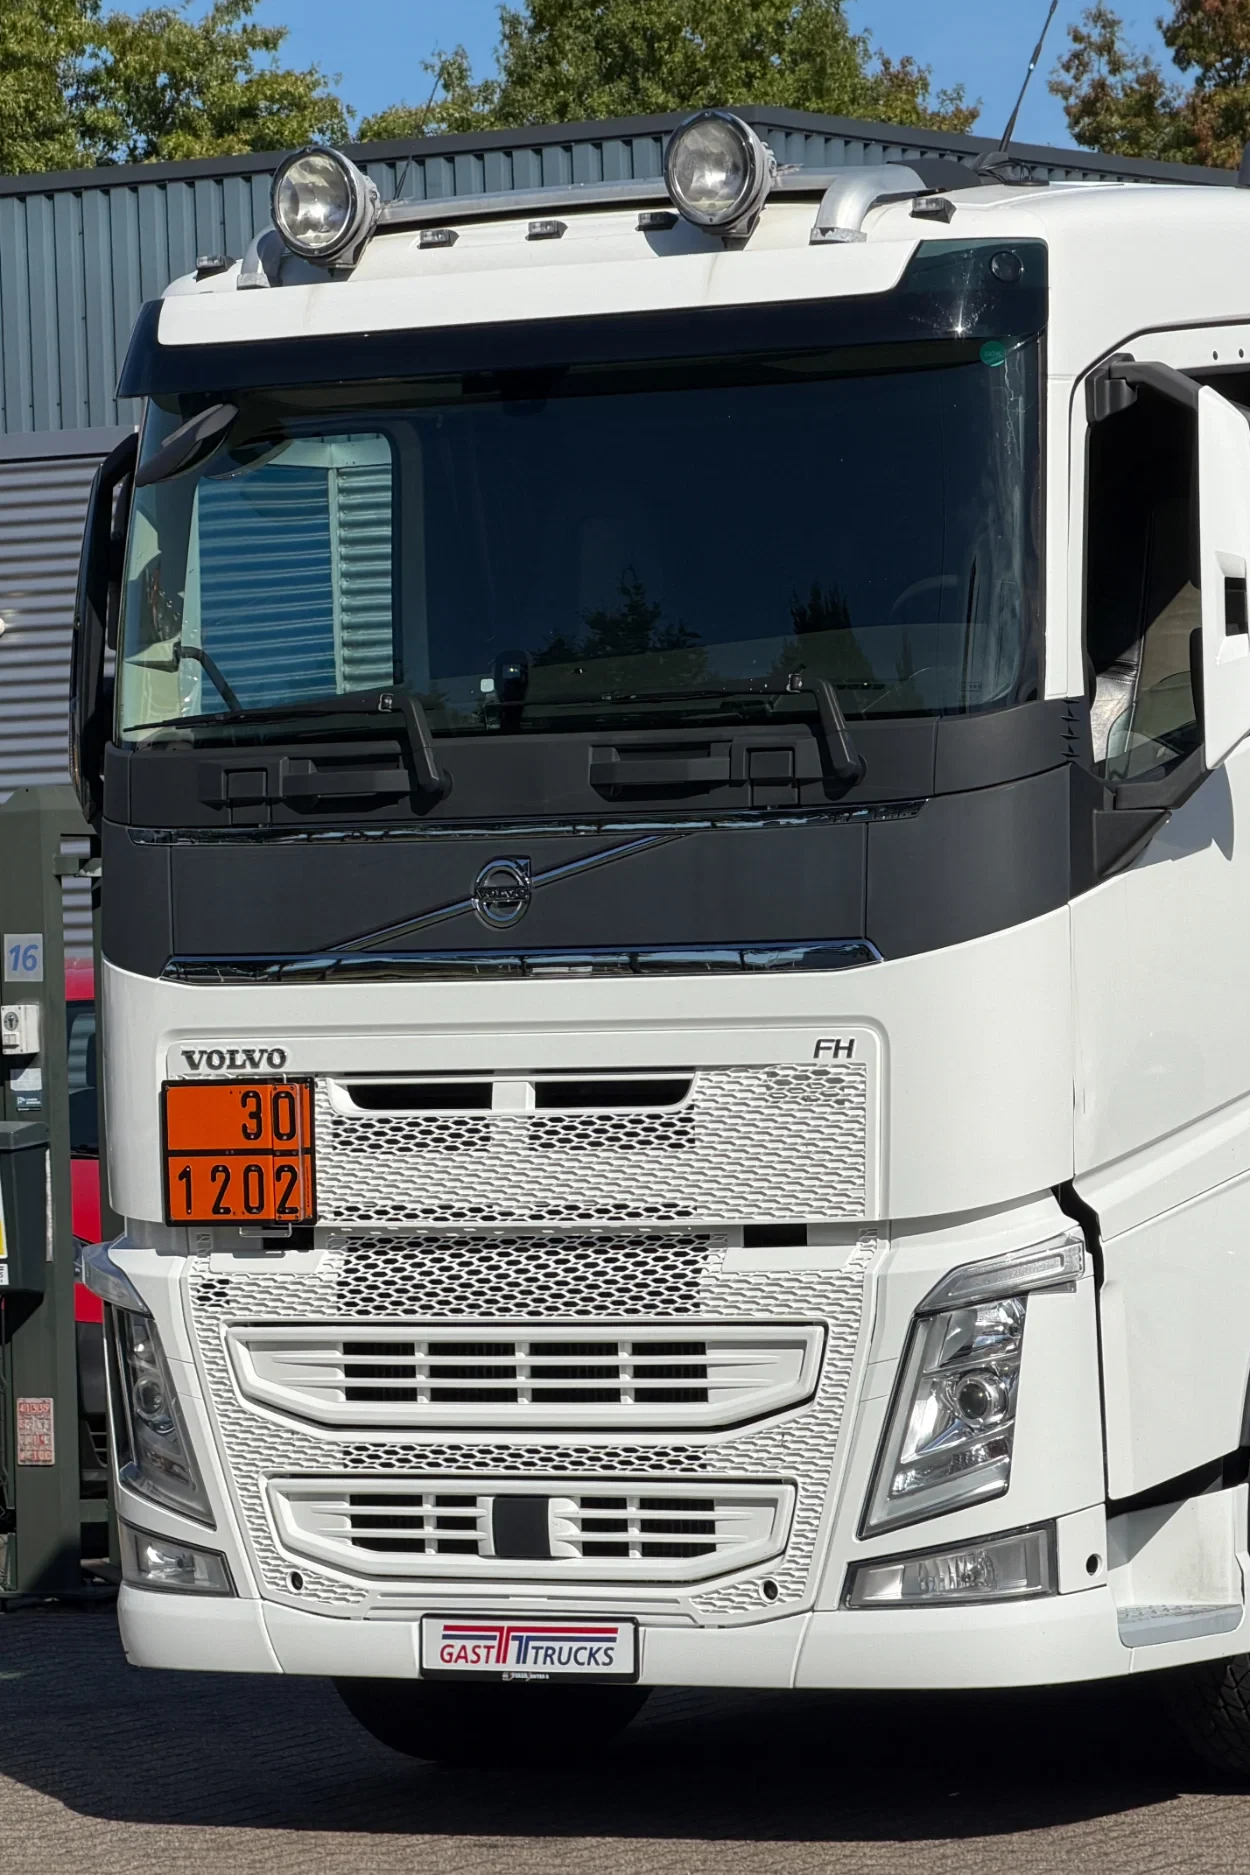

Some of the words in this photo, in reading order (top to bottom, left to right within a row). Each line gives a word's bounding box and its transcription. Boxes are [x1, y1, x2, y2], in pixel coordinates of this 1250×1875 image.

[9, 944, 39, 971] 16
[181, 1048, 287, 1070] VOLVO
[813, 1038, 855, 1058] FH
[241, 1090, 296, 1141] 30
[178, 1164, 299, 1215] 1202
[439, 1644, 495, 1664] GAST
[531, 1646, 615, 1666] TRUCKS
